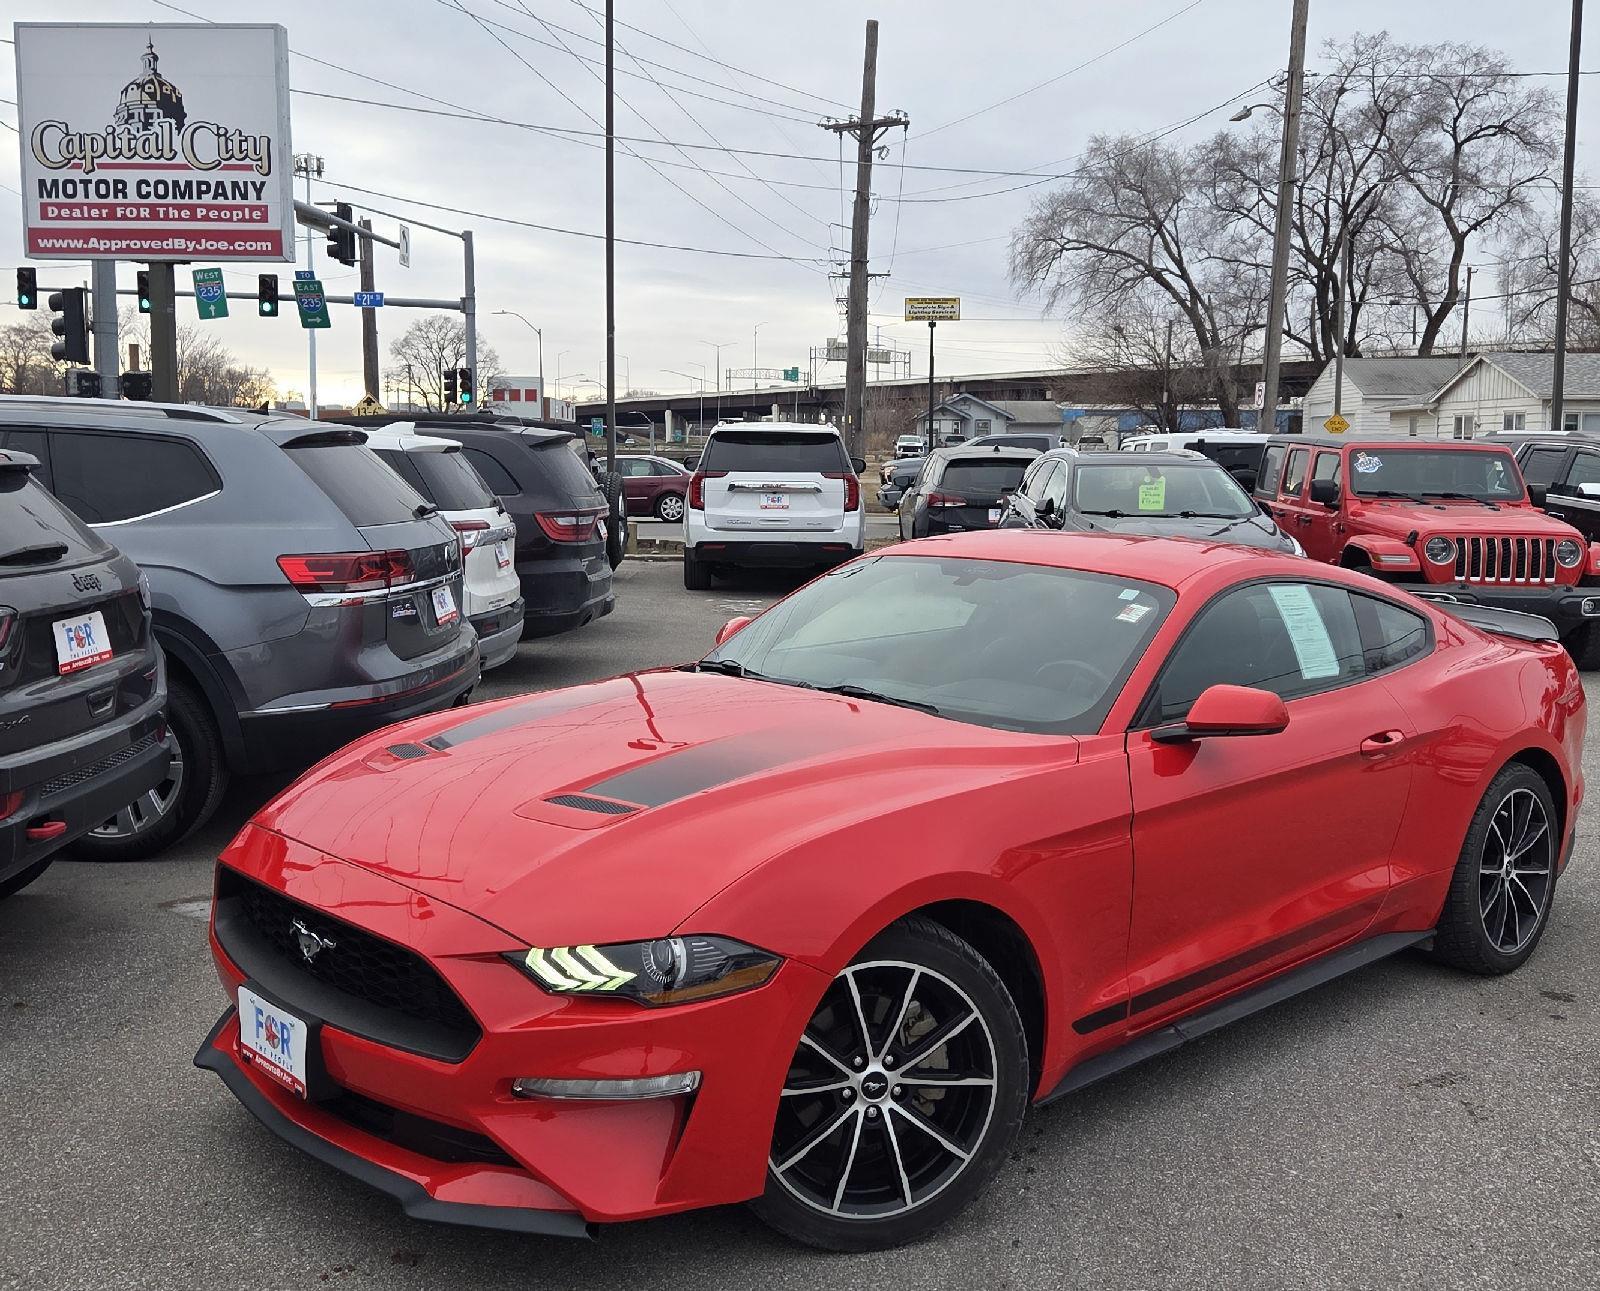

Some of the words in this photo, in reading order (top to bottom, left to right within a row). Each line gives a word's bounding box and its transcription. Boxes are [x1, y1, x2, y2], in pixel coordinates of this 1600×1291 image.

[31, 119, 178, 175] Capital
[181, 120, 271, 177] City
[38, 178, 128, 200] MOTOR
[136, 179, 267, 201] COMPANY
[47, 206, 108, 219] Dealer
[116, 207, 151, 219] FOR
[159, 207, 191, 219] The
[196, 208, 262, 221] People
[37, 237, 272, 251] www.ApprovedByJoe.com
[195, 271, 219, 280] WEST
[200, 286, 221, 297] 235
[296, 283, 318, 291] EAST
[301, 297, 322, 308] 235
[71, 573, 102, 592] Jeep
[254, 1006, 292, 1059] FOR
